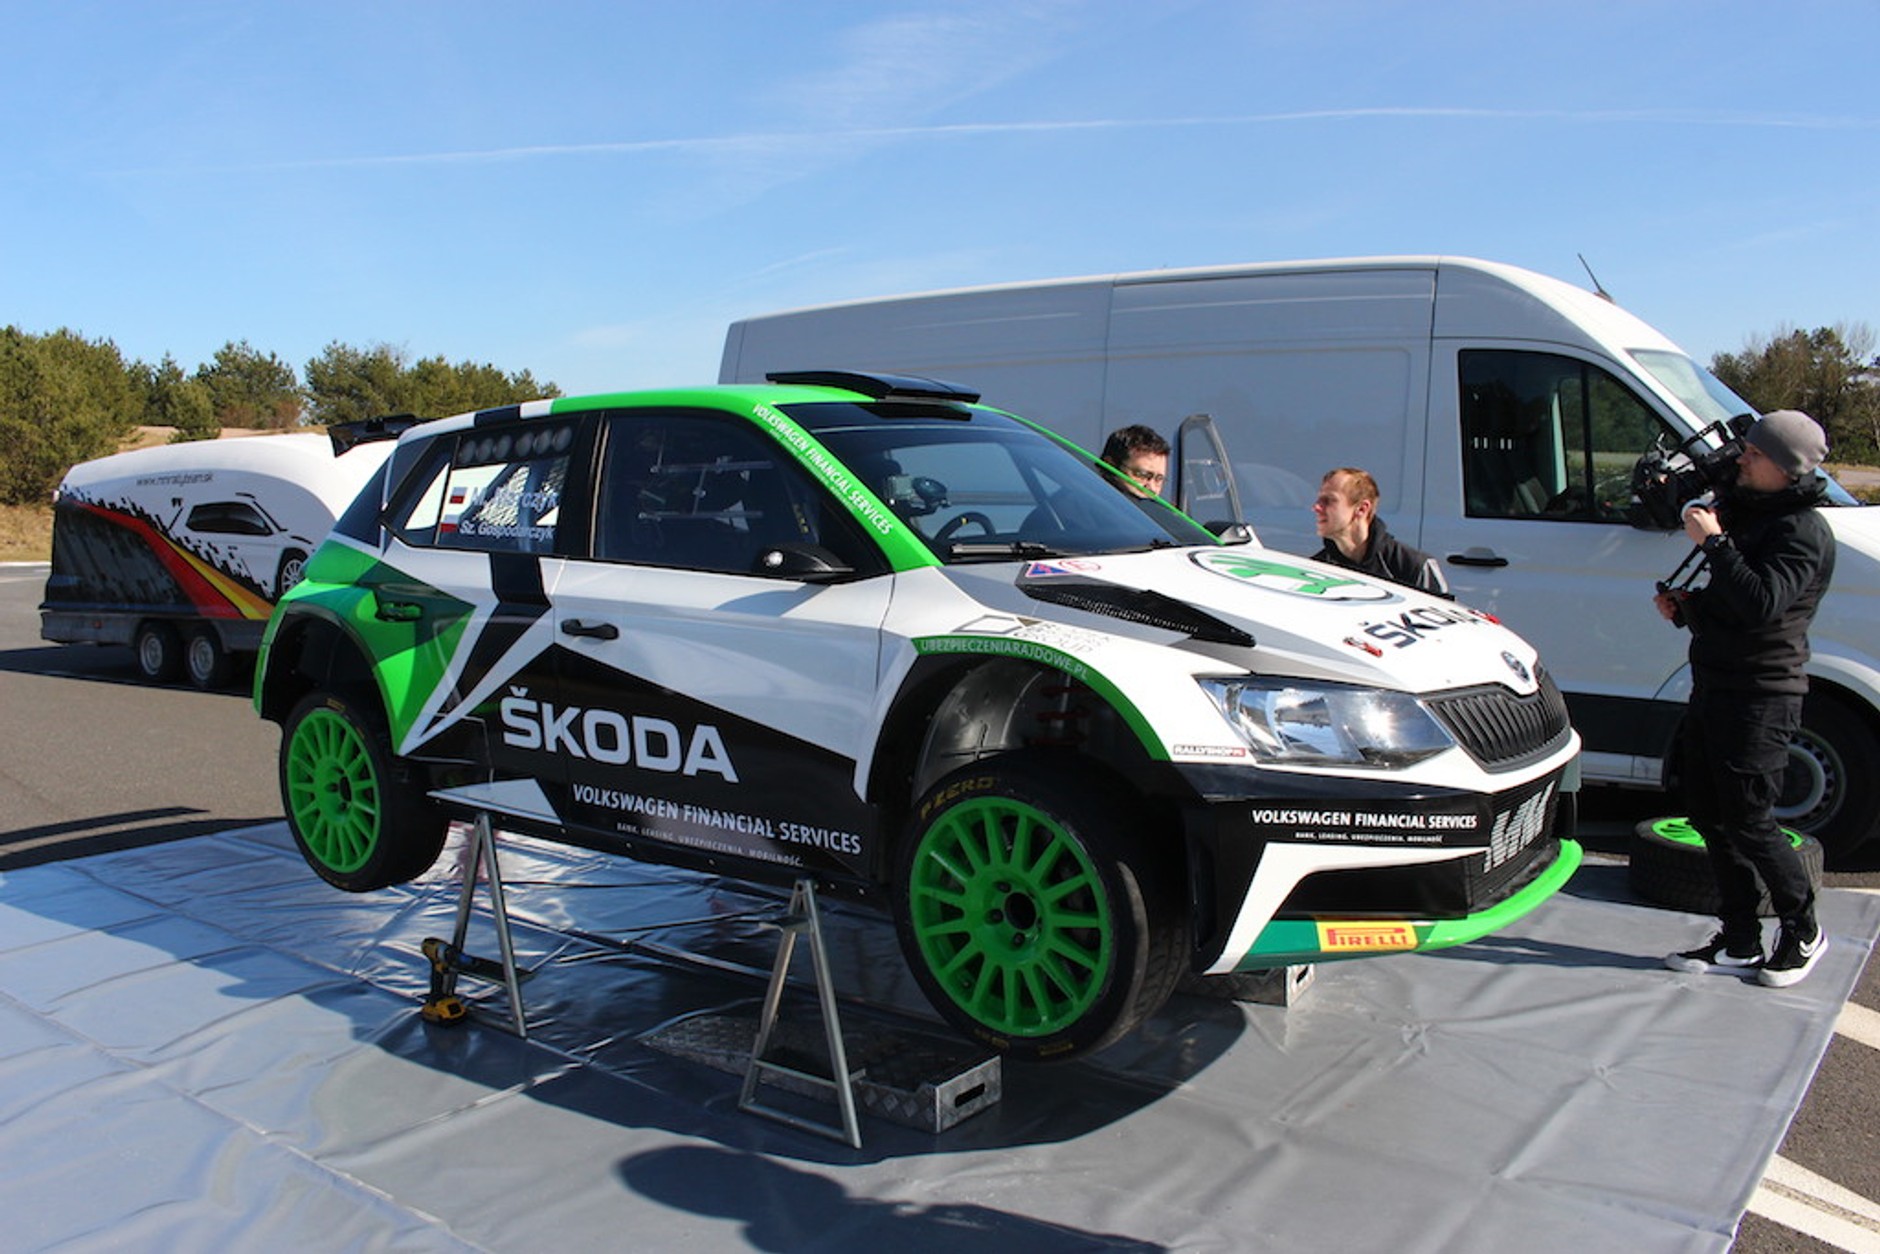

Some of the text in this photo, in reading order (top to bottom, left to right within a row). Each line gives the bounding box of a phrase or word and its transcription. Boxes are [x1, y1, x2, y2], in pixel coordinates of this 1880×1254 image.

[752, 403, 810, 452] VOLKSWAGEN
[805, 447, 851, 495] FINANCIAL
[848, 489, 894, 535] SERVICES
[921, 638, 1089, 680] UBEZPIECZENIARAJDOWE.PL
[501, 686, 740, 784] ŠKODA
[572, 783, 862, 855] VOLKSWAGEN FINANCIAL SERVICES
[1252, 809, 1478, 830] VOLKSWAGEN FINANCIAL SERVICES
[1326, 927, 1408, 946] PIRELLI
